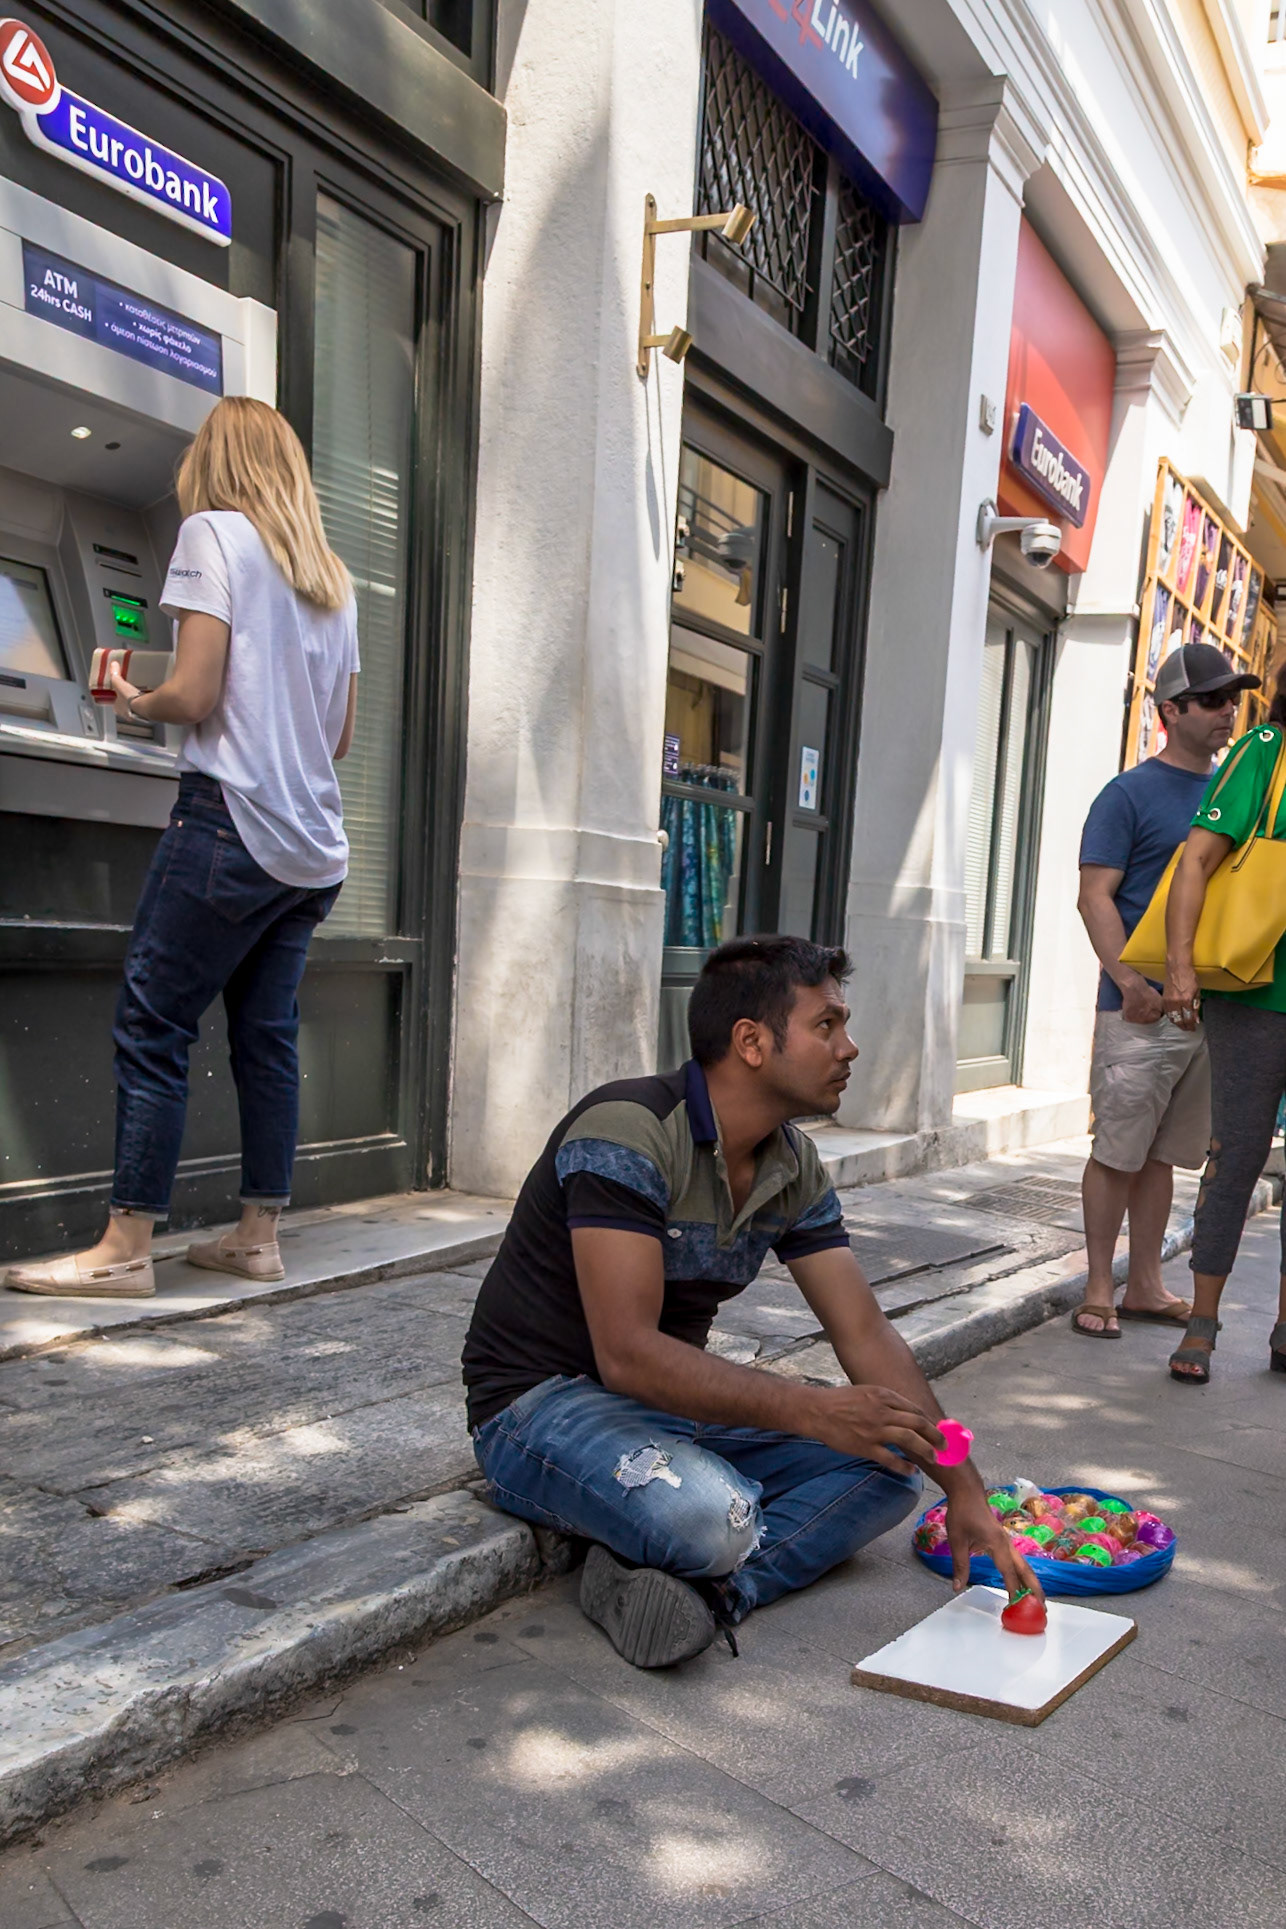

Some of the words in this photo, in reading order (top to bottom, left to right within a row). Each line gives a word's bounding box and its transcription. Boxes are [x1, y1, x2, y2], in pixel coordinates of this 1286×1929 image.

[69, 104, 219, 224] Eurobank
[30, 284, 61, 308] 24hrs
[62, 299, 92, 322] CASH
[43, 269, 78, 298] ATM
[1031, 427, 1083, 511] Eurobank
